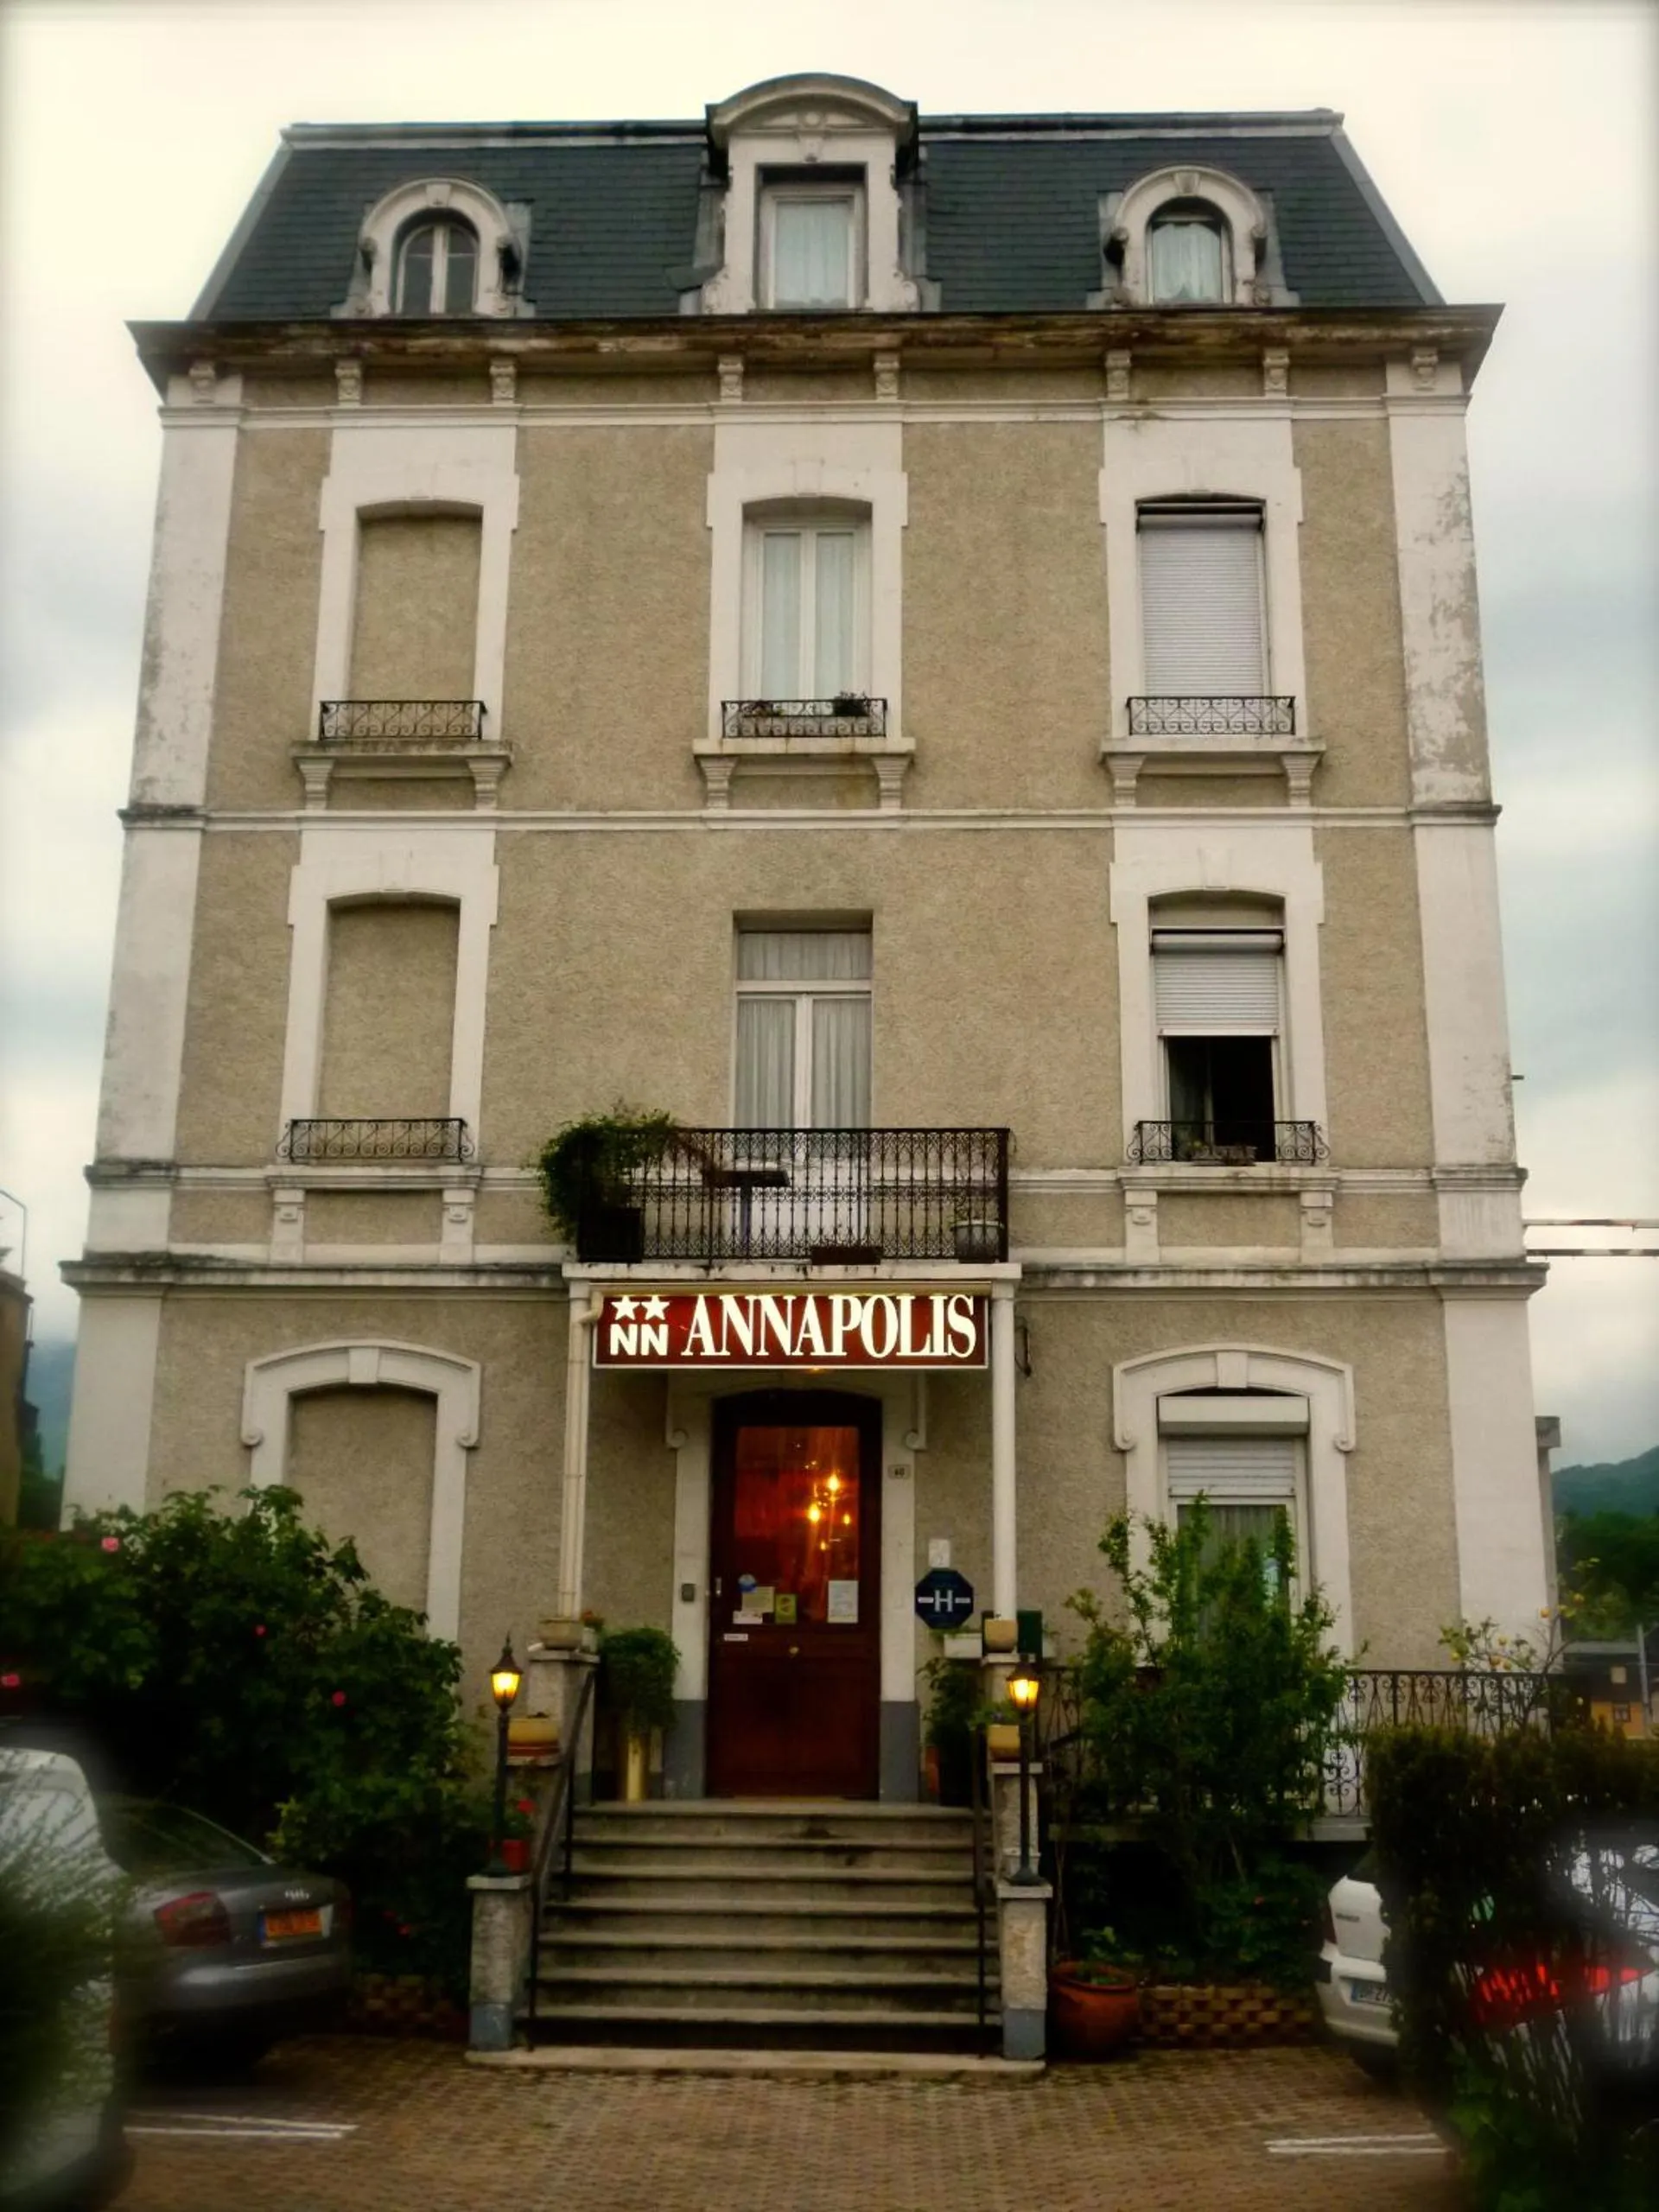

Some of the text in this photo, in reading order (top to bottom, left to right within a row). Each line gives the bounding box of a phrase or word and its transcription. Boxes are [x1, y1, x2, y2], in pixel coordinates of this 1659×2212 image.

[610, 1324, 669, 1356] NN
[681, 1294, 976, 1358] ANNAPOLIS
[934, 1589, 954, 1613] H
